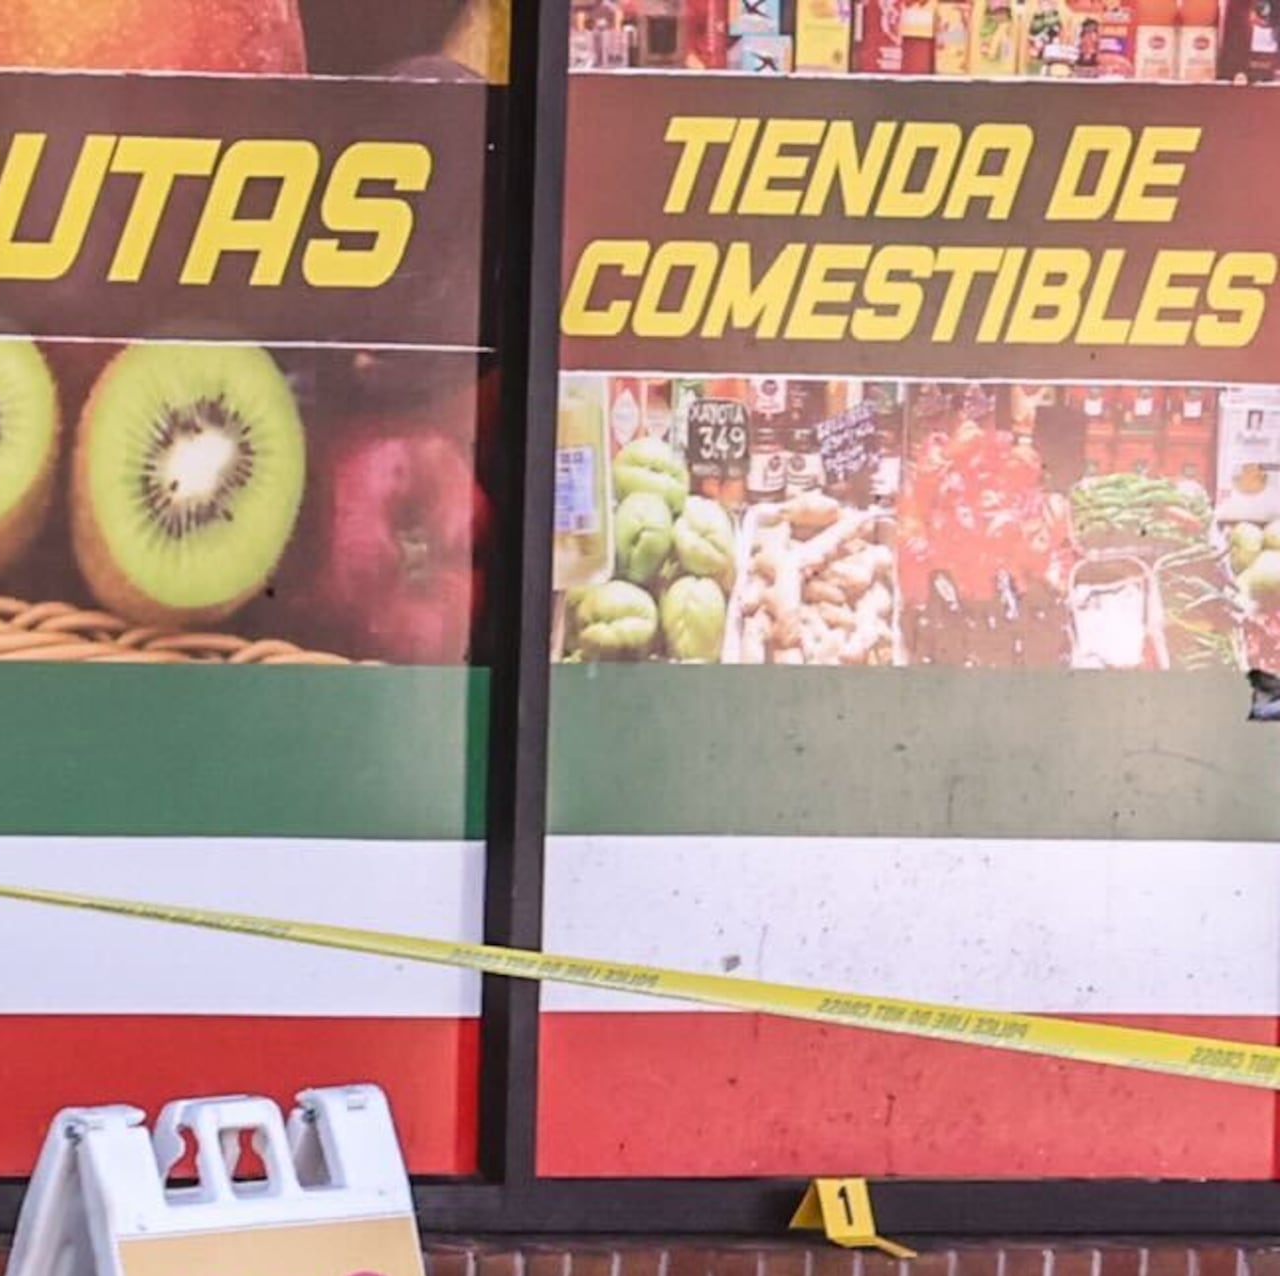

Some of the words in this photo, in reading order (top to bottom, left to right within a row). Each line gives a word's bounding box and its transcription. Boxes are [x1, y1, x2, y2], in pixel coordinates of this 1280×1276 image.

[662, 116, 1034, 221] TIENDA
[1045, 125, 1202, 223] DE
[560, 240, 1277, 347] COMESTIBLES
[837, 1185, 855, 1226] 1
